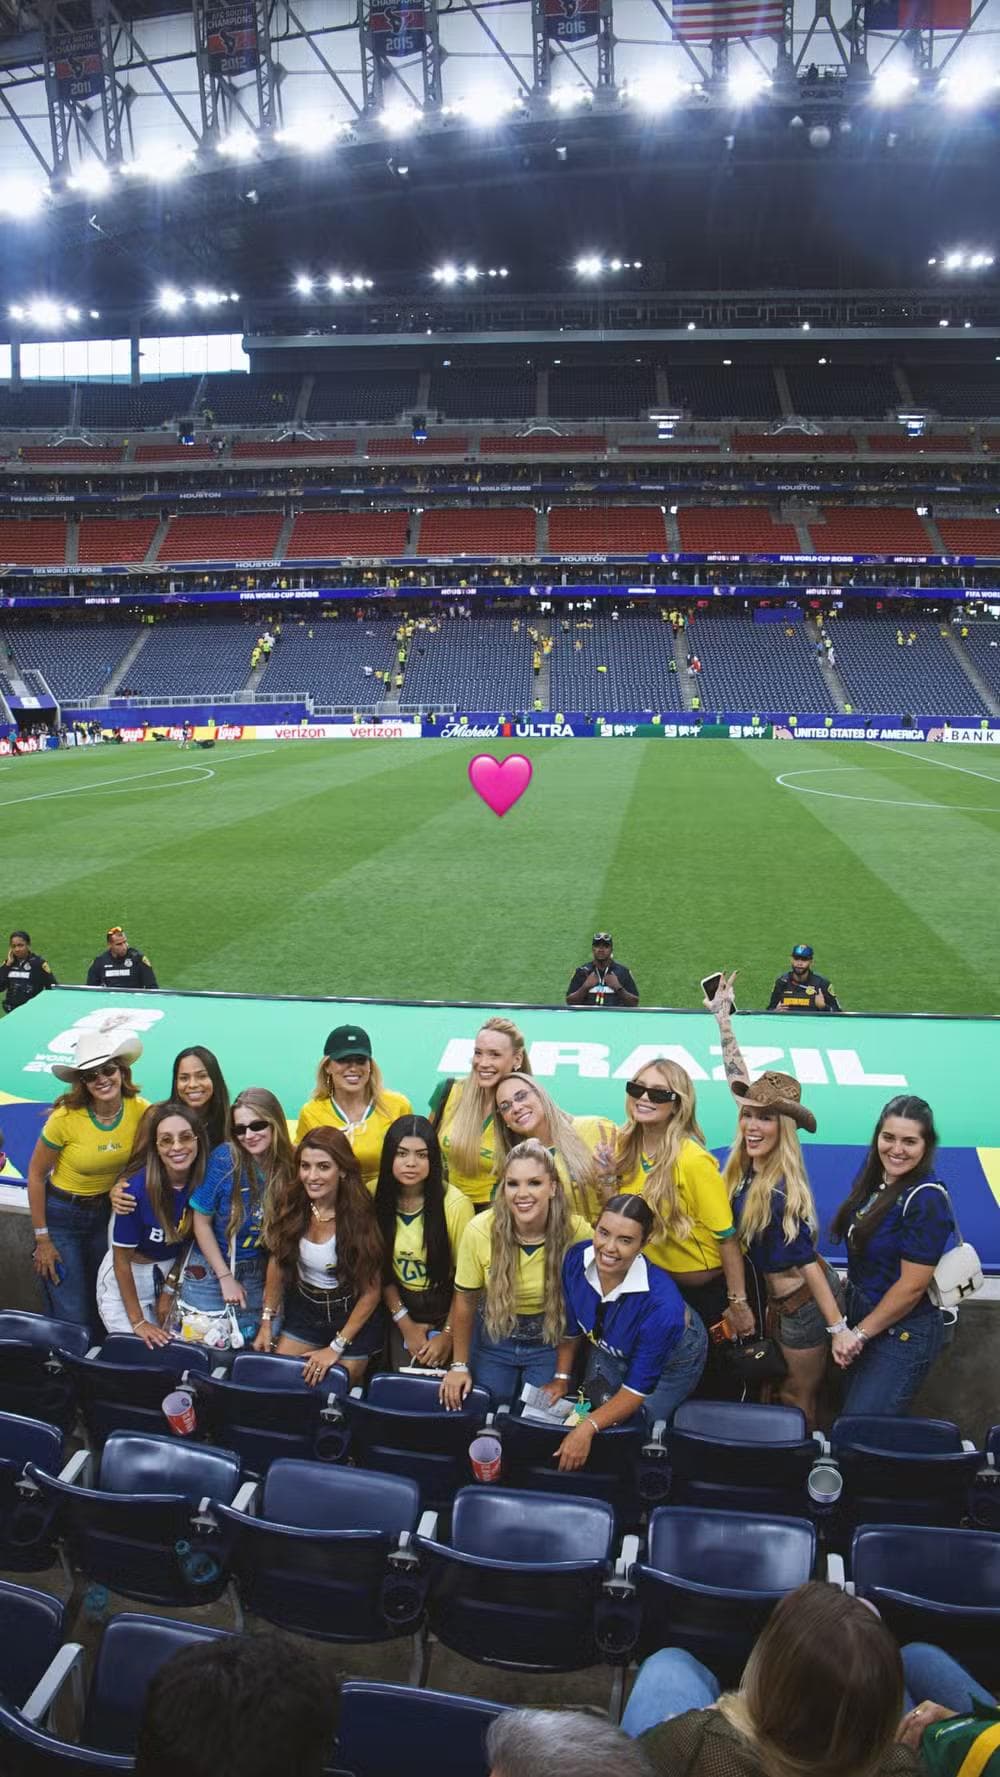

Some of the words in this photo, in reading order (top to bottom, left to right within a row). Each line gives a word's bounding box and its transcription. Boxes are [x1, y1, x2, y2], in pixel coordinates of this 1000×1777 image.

[207, 15, 253, 29] CHAMPIONS
[557, 21, 586, 35] 2016
[386, 36, 414, 51] 2015
[220, 56, 246, 71] 2012
[70, 80, 92, 95] 2011
[240, 592, 254, 600] FIFA
[275, 726, 326, 738] verizon
[350, 725, 402, 737] verizon
[440, 723, 499, 738] Michelob
[516, 724, 575, 737] ULTRA
[794, 728, 829, 738] UNITED
[830, 728, 865, 738] STATES
[866, 729, 879, 738] OF
[880, 729, 925, 740] AMERICA
[951, 730, 995, 741] BANK
